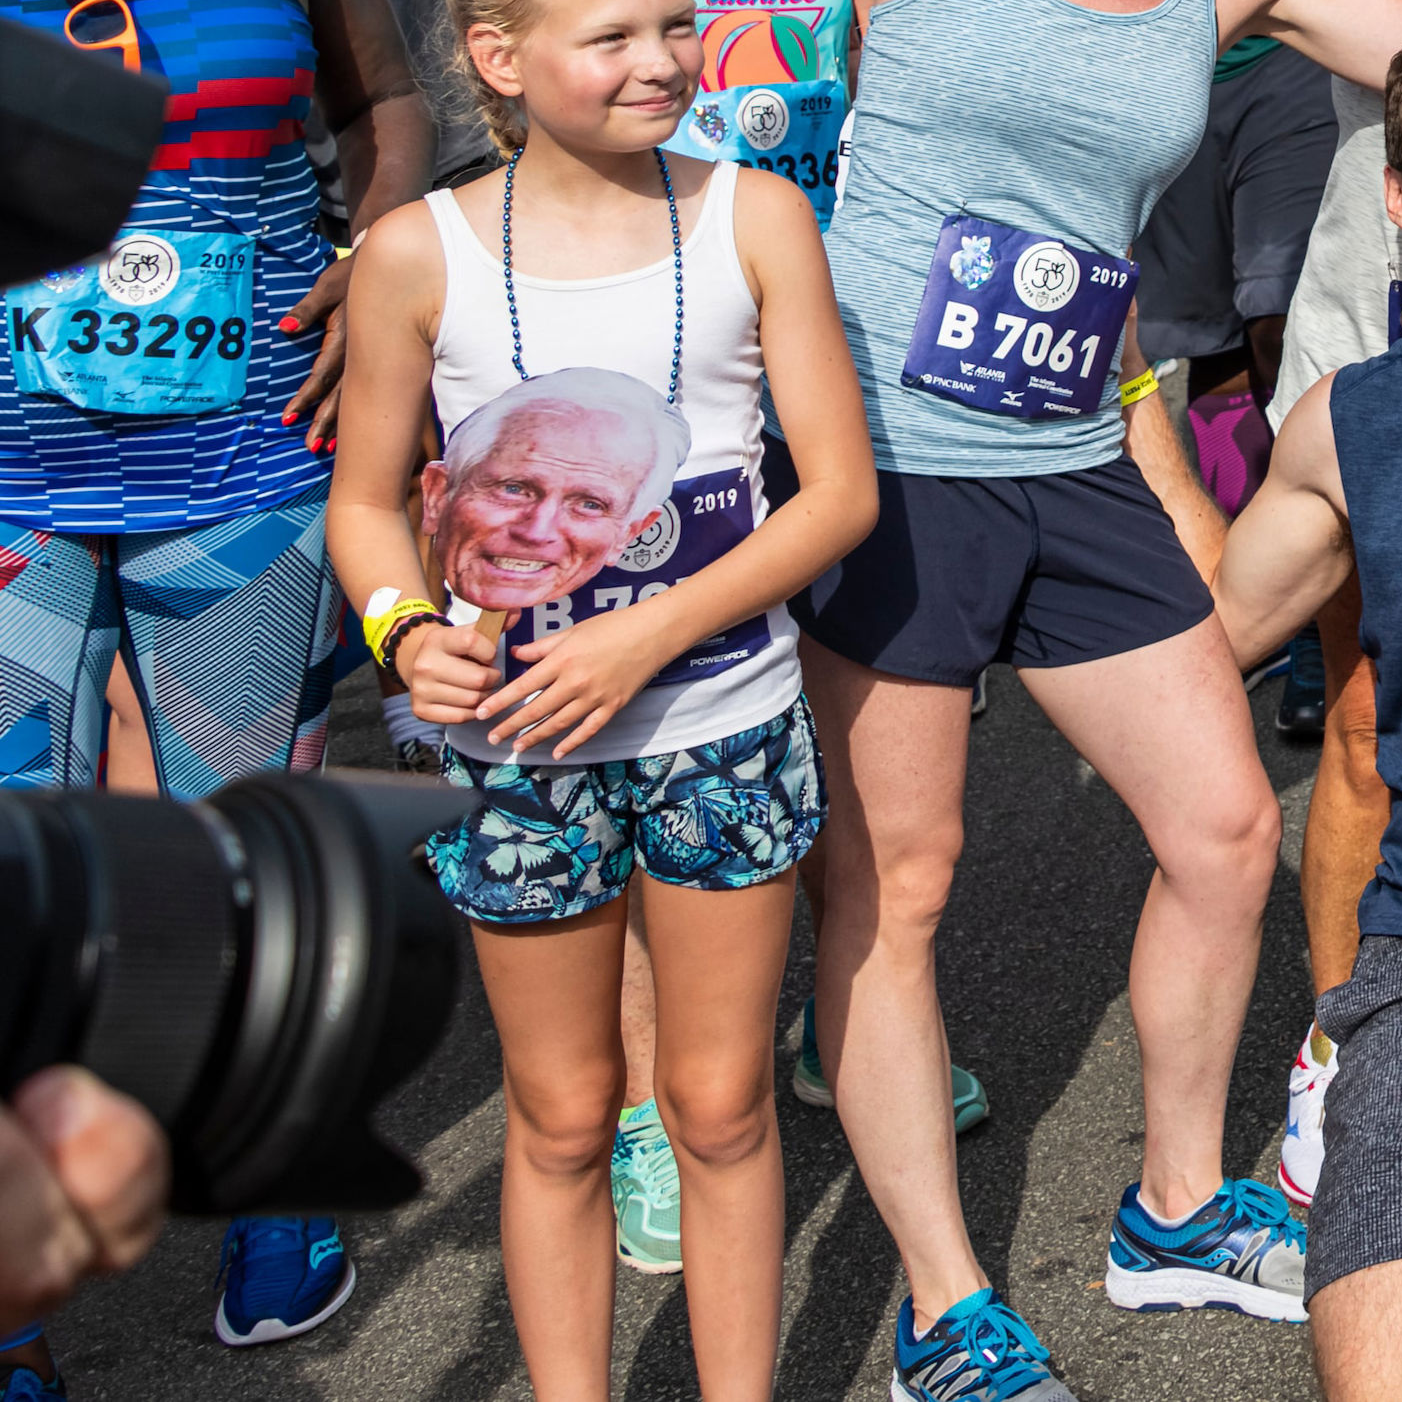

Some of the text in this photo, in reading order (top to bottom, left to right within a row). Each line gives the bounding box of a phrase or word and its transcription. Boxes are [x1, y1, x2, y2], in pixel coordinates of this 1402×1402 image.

[801, 97, 832, 111] 2019
[200, 253, 245, 270] 2019
[1089, 266, 1129, 289] 2019
[12, 307, 247, 361] K 33298
[936, 301, 1101, 378] B 7061
[693, 488, 738, 515] 2019
